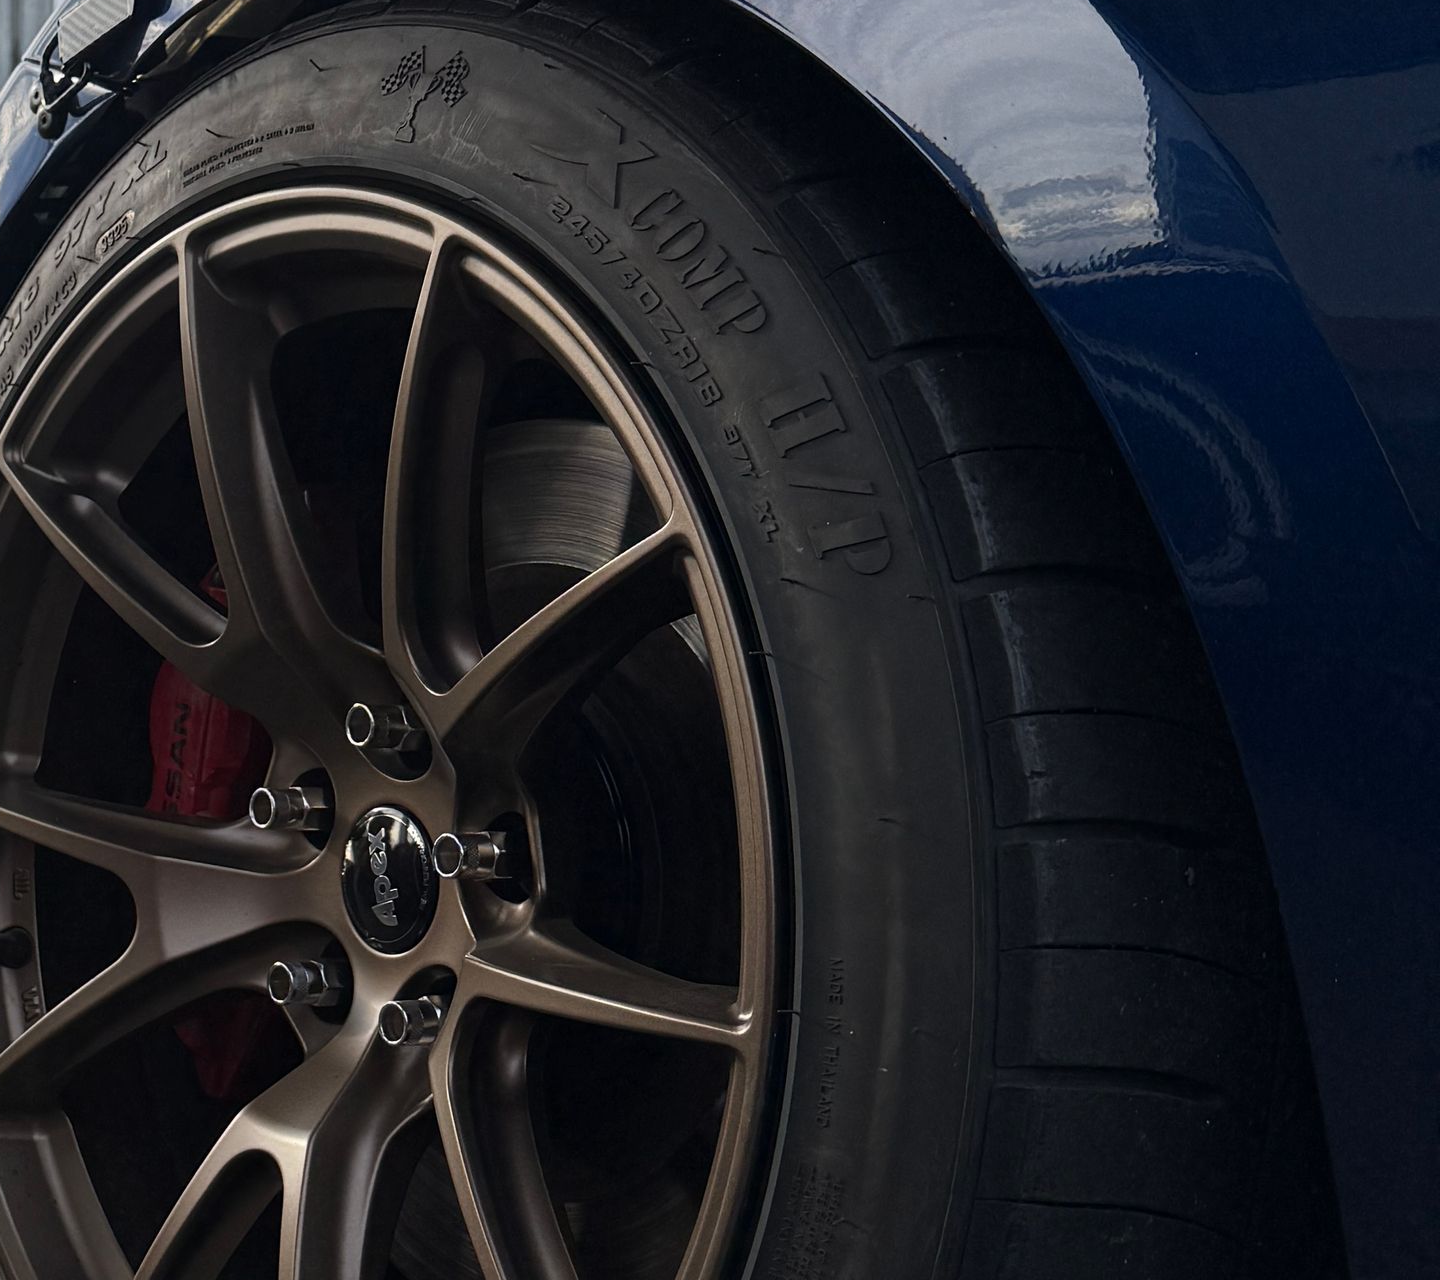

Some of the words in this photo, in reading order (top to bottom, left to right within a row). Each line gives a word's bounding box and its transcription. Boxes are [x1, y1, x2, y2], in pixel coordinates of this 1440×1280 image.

[828, 958, 844, 1006] MADE
[827, 1016, 843, 1038] IN
[818, 1045, 840, 1130] THAILAND
